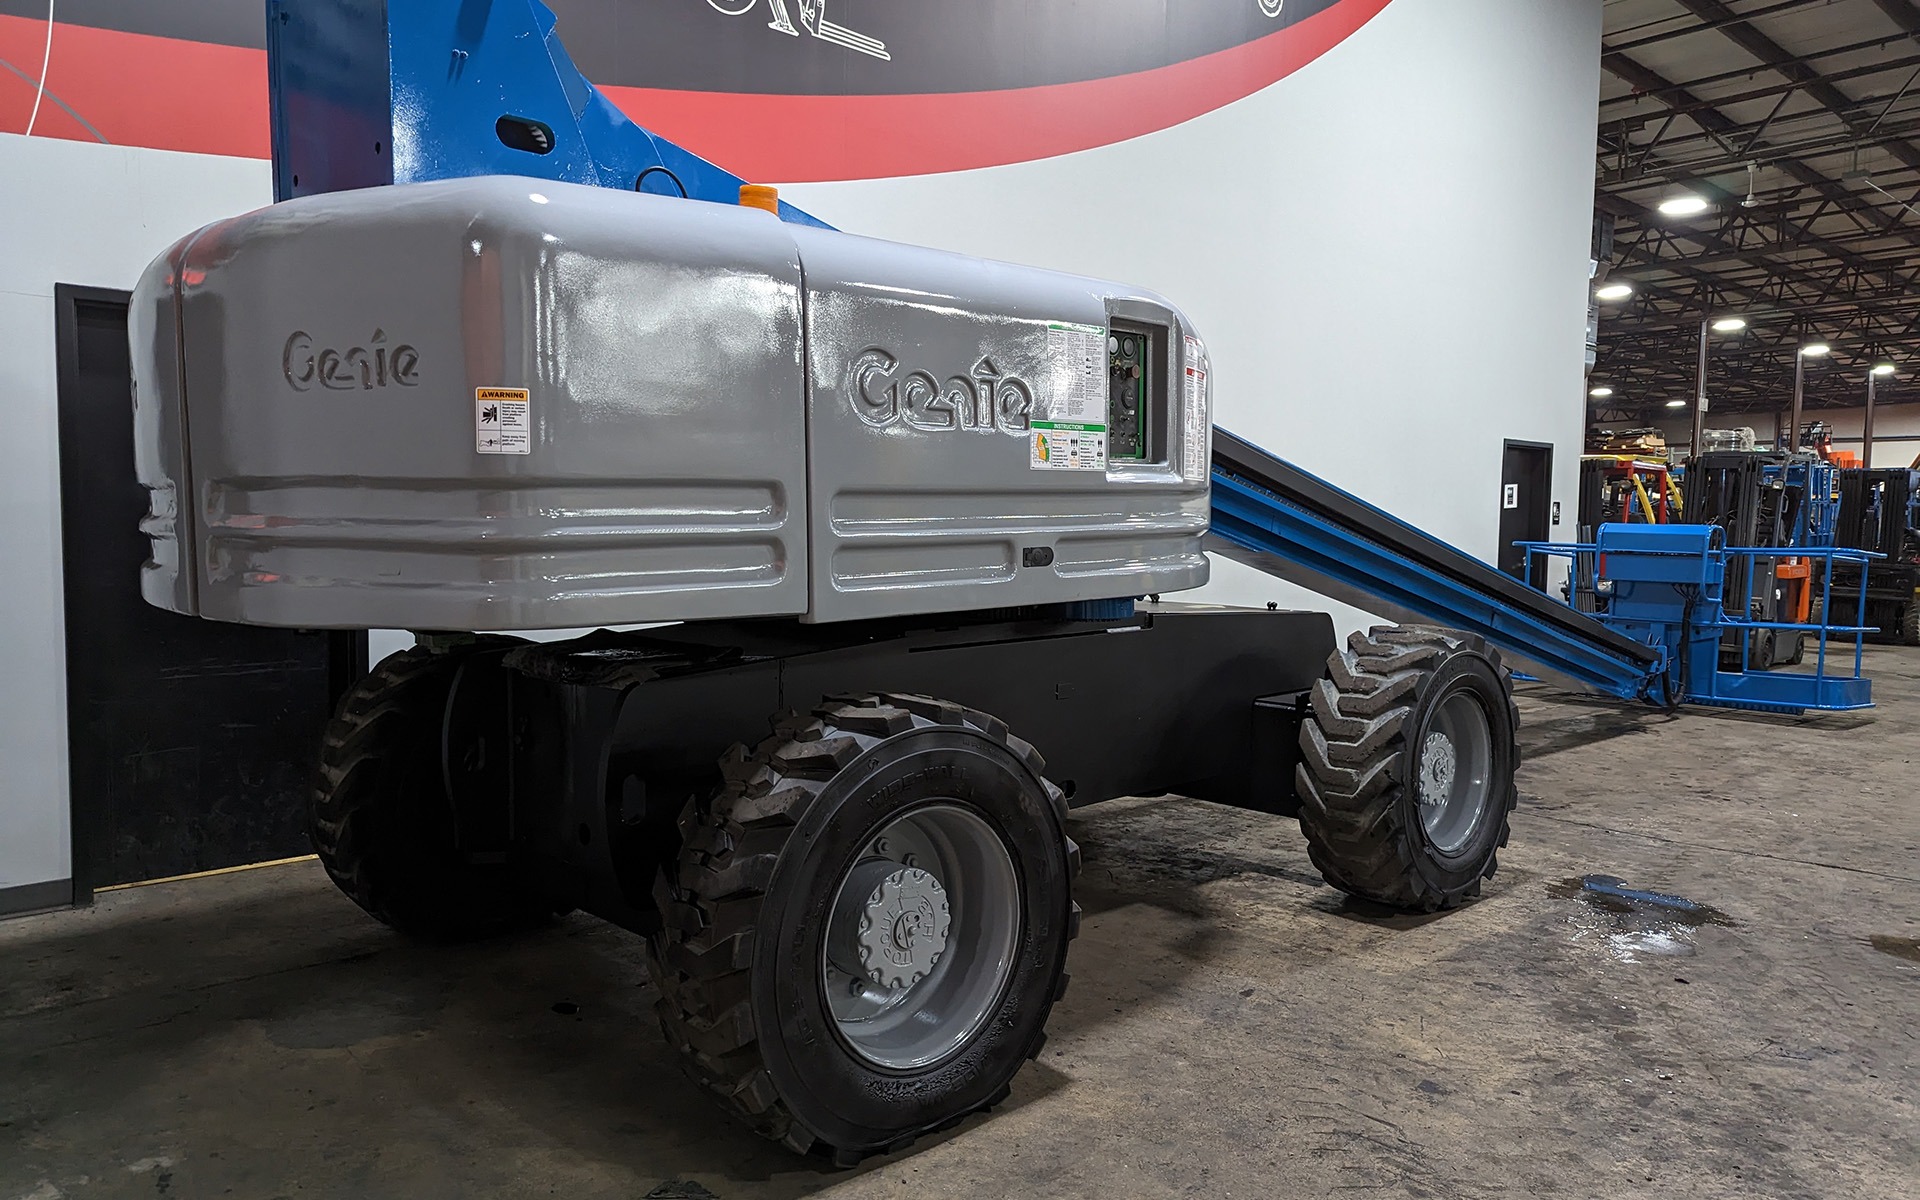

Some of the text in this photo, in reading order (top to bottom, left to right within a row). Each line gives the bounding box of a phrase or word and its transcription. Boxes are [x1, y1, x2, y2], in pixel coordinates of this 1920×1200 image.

[283, 331, 420, 392] Genie
[848, 343, 1035, 437] Genie
[487, 391, 524, 399] WARNING
